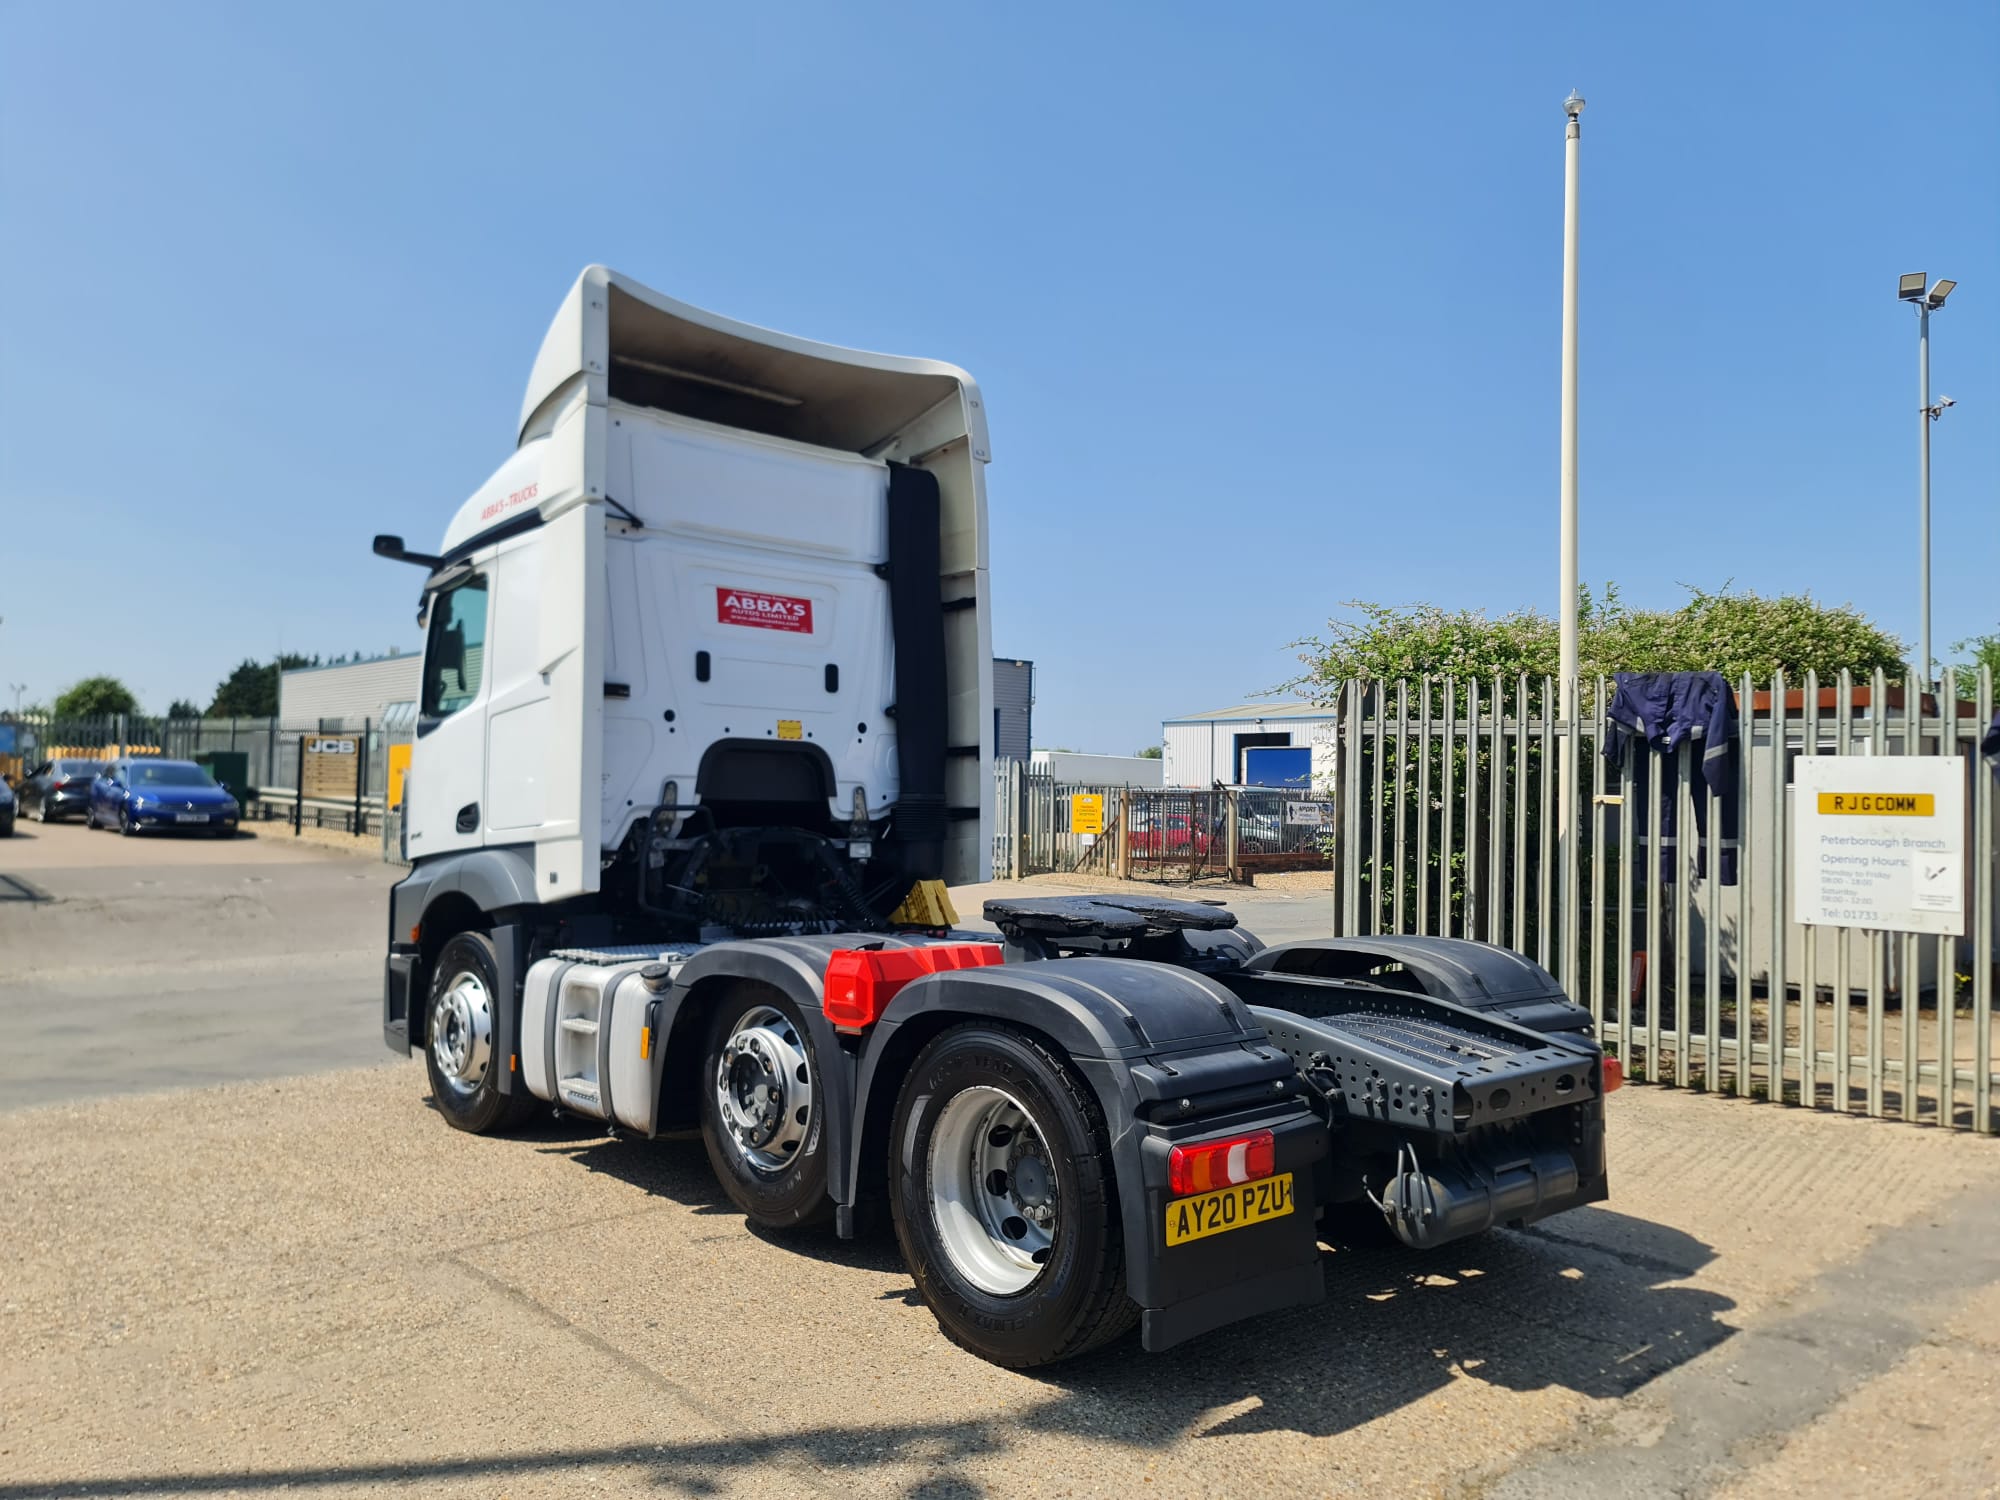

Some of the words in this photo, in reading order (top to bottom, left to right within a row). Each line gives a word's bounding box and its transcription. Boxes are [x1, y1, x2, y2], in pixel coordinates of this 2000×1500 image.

[724, 595, 806, 617] ABBA'S
[730, 608, 760, 617] AUTOS
[762, 612, 800, 622] LIMITED
[307, 739, 355, 753] JCB
[1820, 834, 1900, 850] Peterborough
[1902, 838, 1946, 849] Branch
[1820, 854, 1870, 867] Opening
[1821, 868, 1853, 878] Monday
[1855, 870, 1865, 878] to
[1866, 870, 1891, 880] Friday
[1821, 887, 1858, 897] Saturday
[1821, 908, 1841, 919] Tel:
[1843, 909, 1879, 922] 01733
[1177, 1192, 1236, 1238] AY20
[1242, 1180, 1284, 1220] PZU
